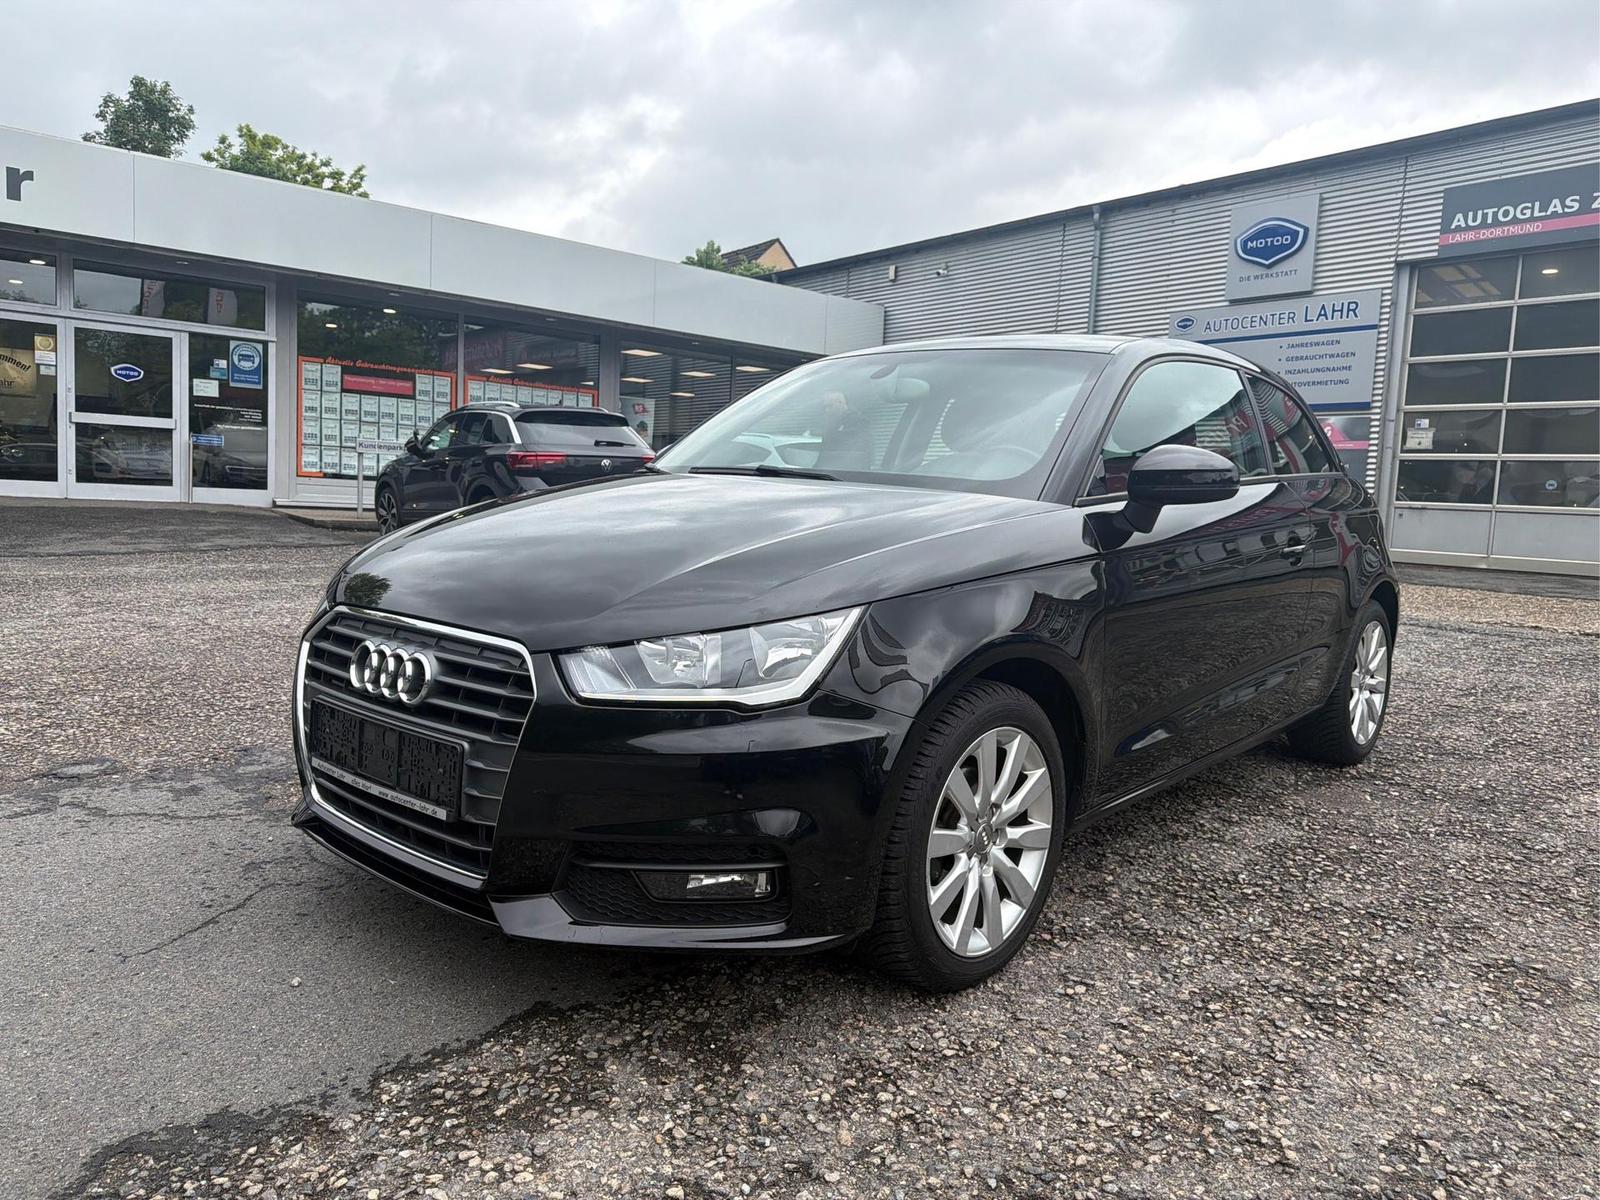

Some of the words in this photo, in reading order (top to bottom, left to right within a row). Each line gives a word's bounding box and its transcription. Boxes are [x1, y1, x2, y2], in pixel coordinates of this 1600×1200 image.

[1450, 195, 1580, 229] AUTOGLAS
[1448, 222, 1542, 243] LAHR-DORTMUND
[1247, 235, 1291, 249] MOTOO
[1253, 269, 1298, 281] WERKSTATT
[1203, 311, 1296, 333] AUTOCENTER
[1304, 301, 1360, 323] LAHR
[1286, 339, 1341, 350] JAHRESWAGEN
[1285, 351, 1356, 362] GEBRAUCHTWAGEN
[1284, 365, 1352, 376] INZAHLUNGNAHME
[1291, 378, 1350, 388] TOVERMIETUNG
